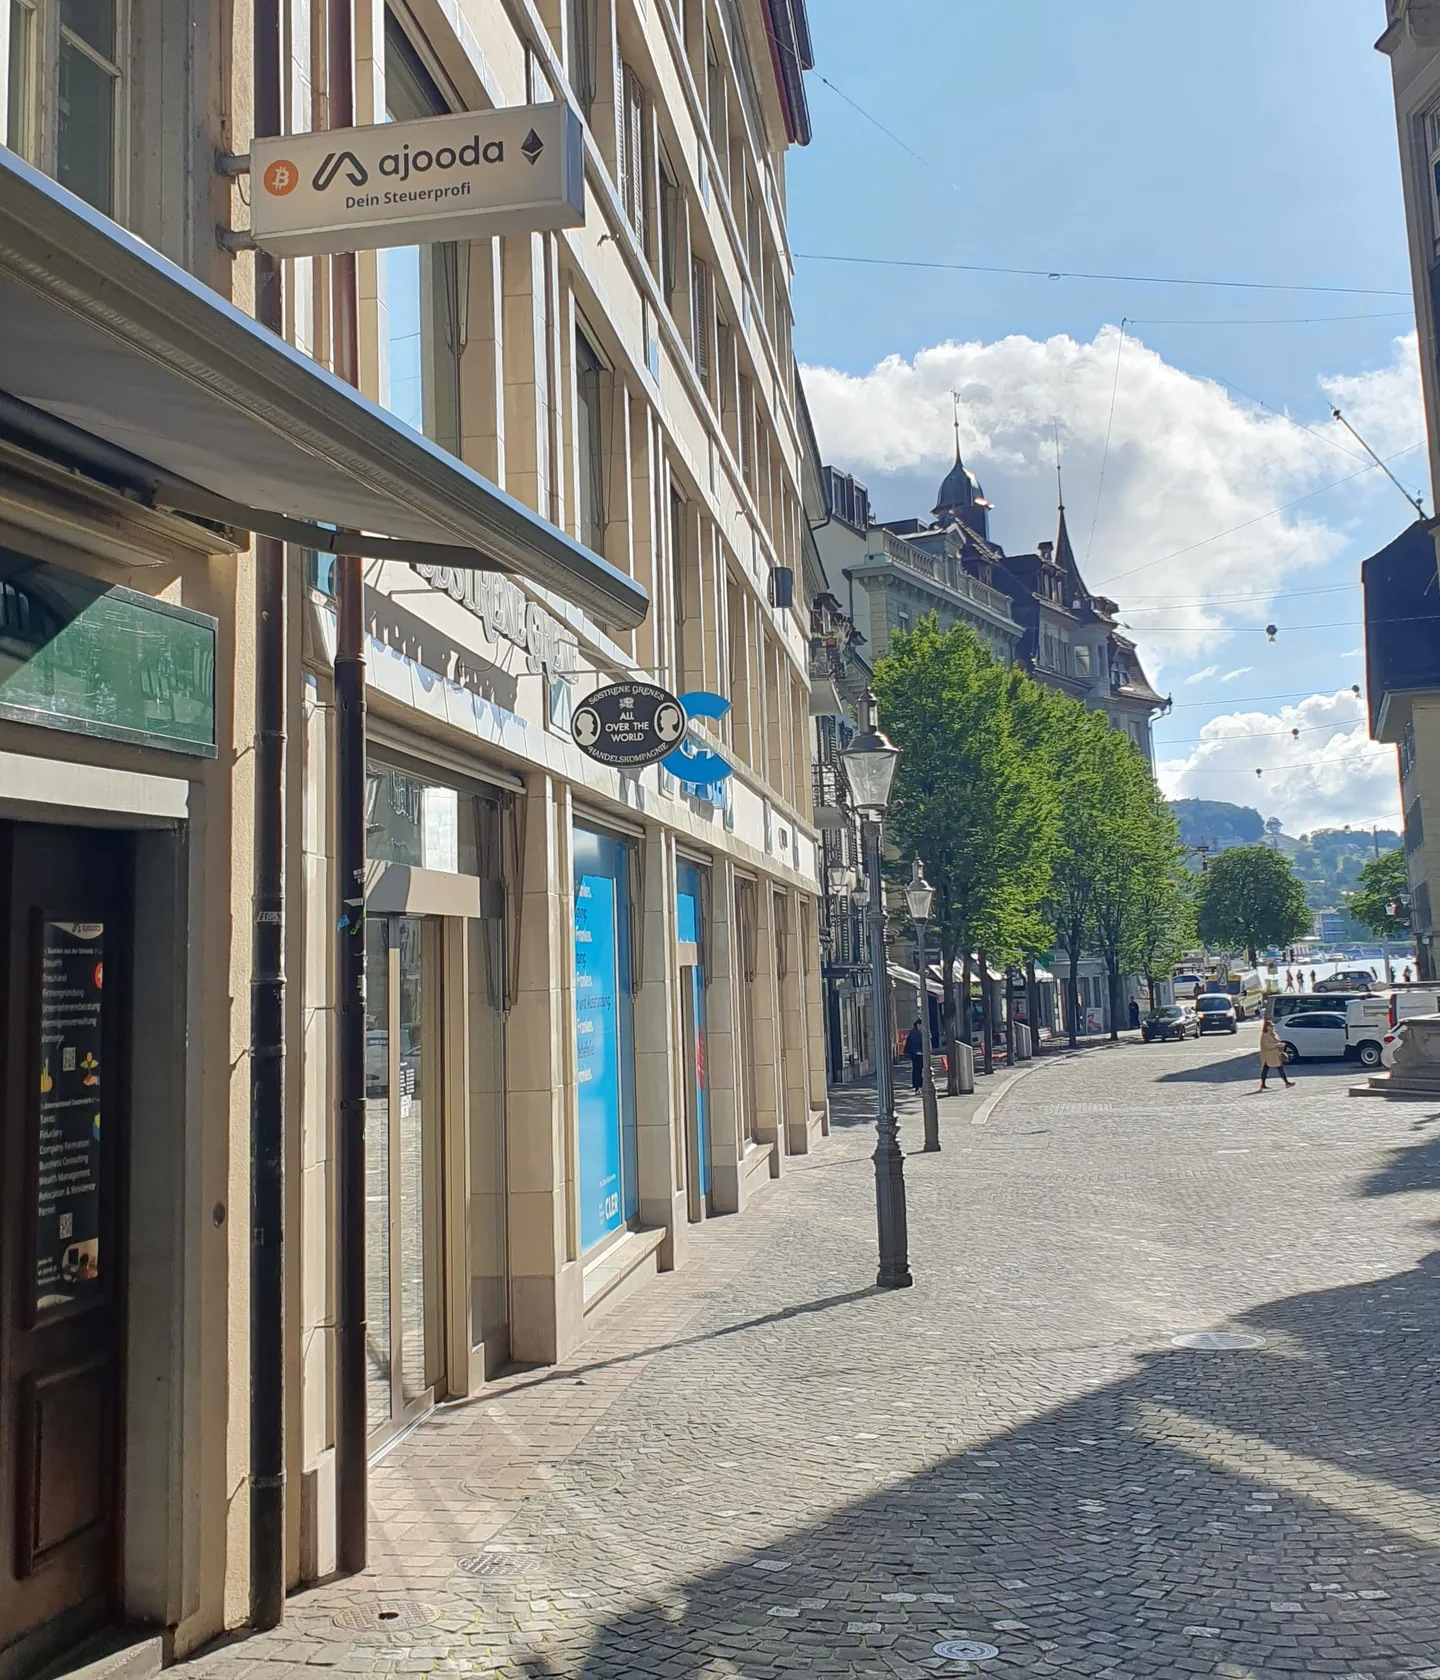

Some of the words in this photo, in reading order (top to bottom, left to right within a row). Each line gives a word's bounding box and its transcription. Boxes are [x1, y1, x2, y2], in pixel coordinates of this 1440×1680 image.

[378, 135, 504, 181] ajooda
[345, 193, 379, 209] Dein
[384, 181, 471, 204] Steuerprofi
[588, 685, 631, 705] SØSTRENE
[631, 685, 665, 701] GRENES
[619, 711, 635, 720] ALL
[605, 722, 630, 732] OVER
[632, 721, 650, 730] THE
[610, 732, 644, 742] WORLD
[587, 742, 669, 763] HANDELSKOMPAGNIE
